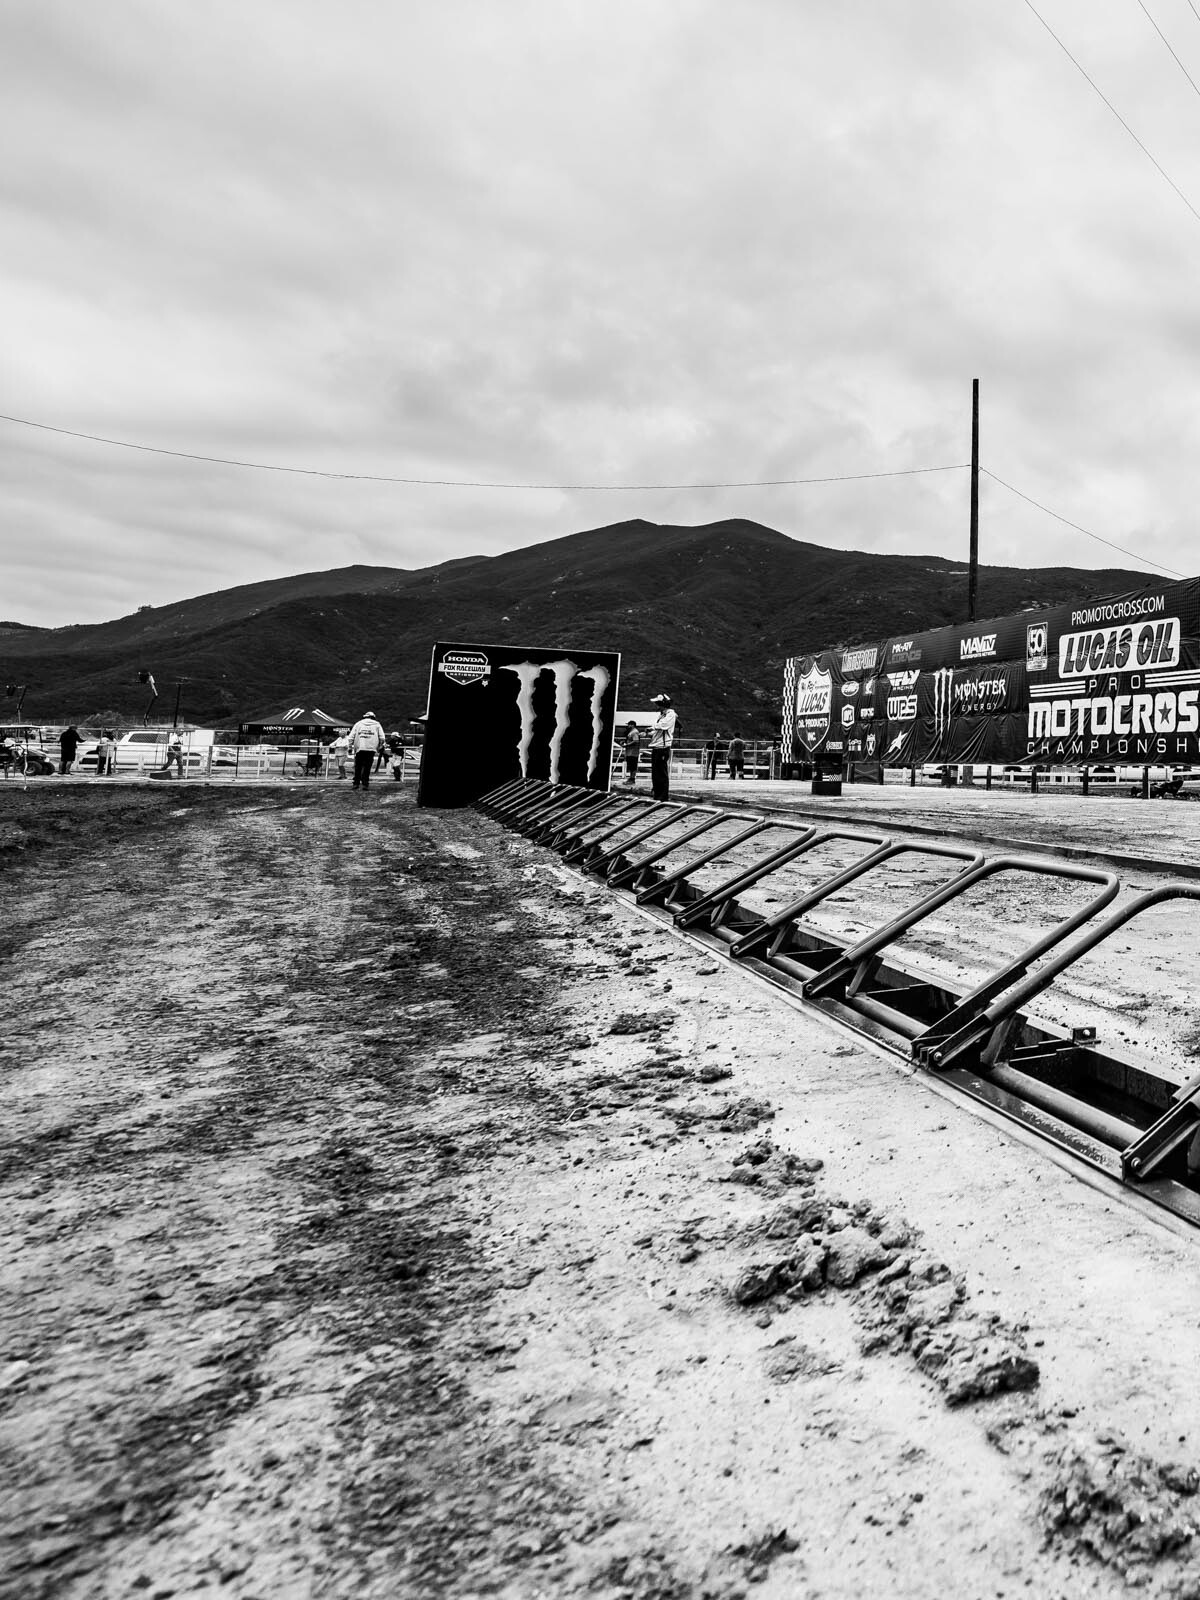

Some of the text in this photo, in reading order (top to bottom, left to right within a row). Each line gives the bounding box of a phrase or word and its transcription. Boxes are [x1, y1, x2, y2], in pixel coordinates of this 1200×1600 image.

[1071, 595, 1165, 626] PROMOTOCROSS.COM
[961, 634, 997, 655] MAVTV
[1031, 629, 1044, 653] 50
[1063, 628, 1133, 674] LUCAS
[1136, 622, 1174, 665] OIL
[887, 669, 920, 687] FLY
[1089, 675, 1141, 692] PRO
[954, 678, 1006, 700] MONSTER
[800, 691, 828, 713] LUCAS
[961, 702, 998, 713] ENERGY
[805, 718, 828, 728] PRODUCTS
